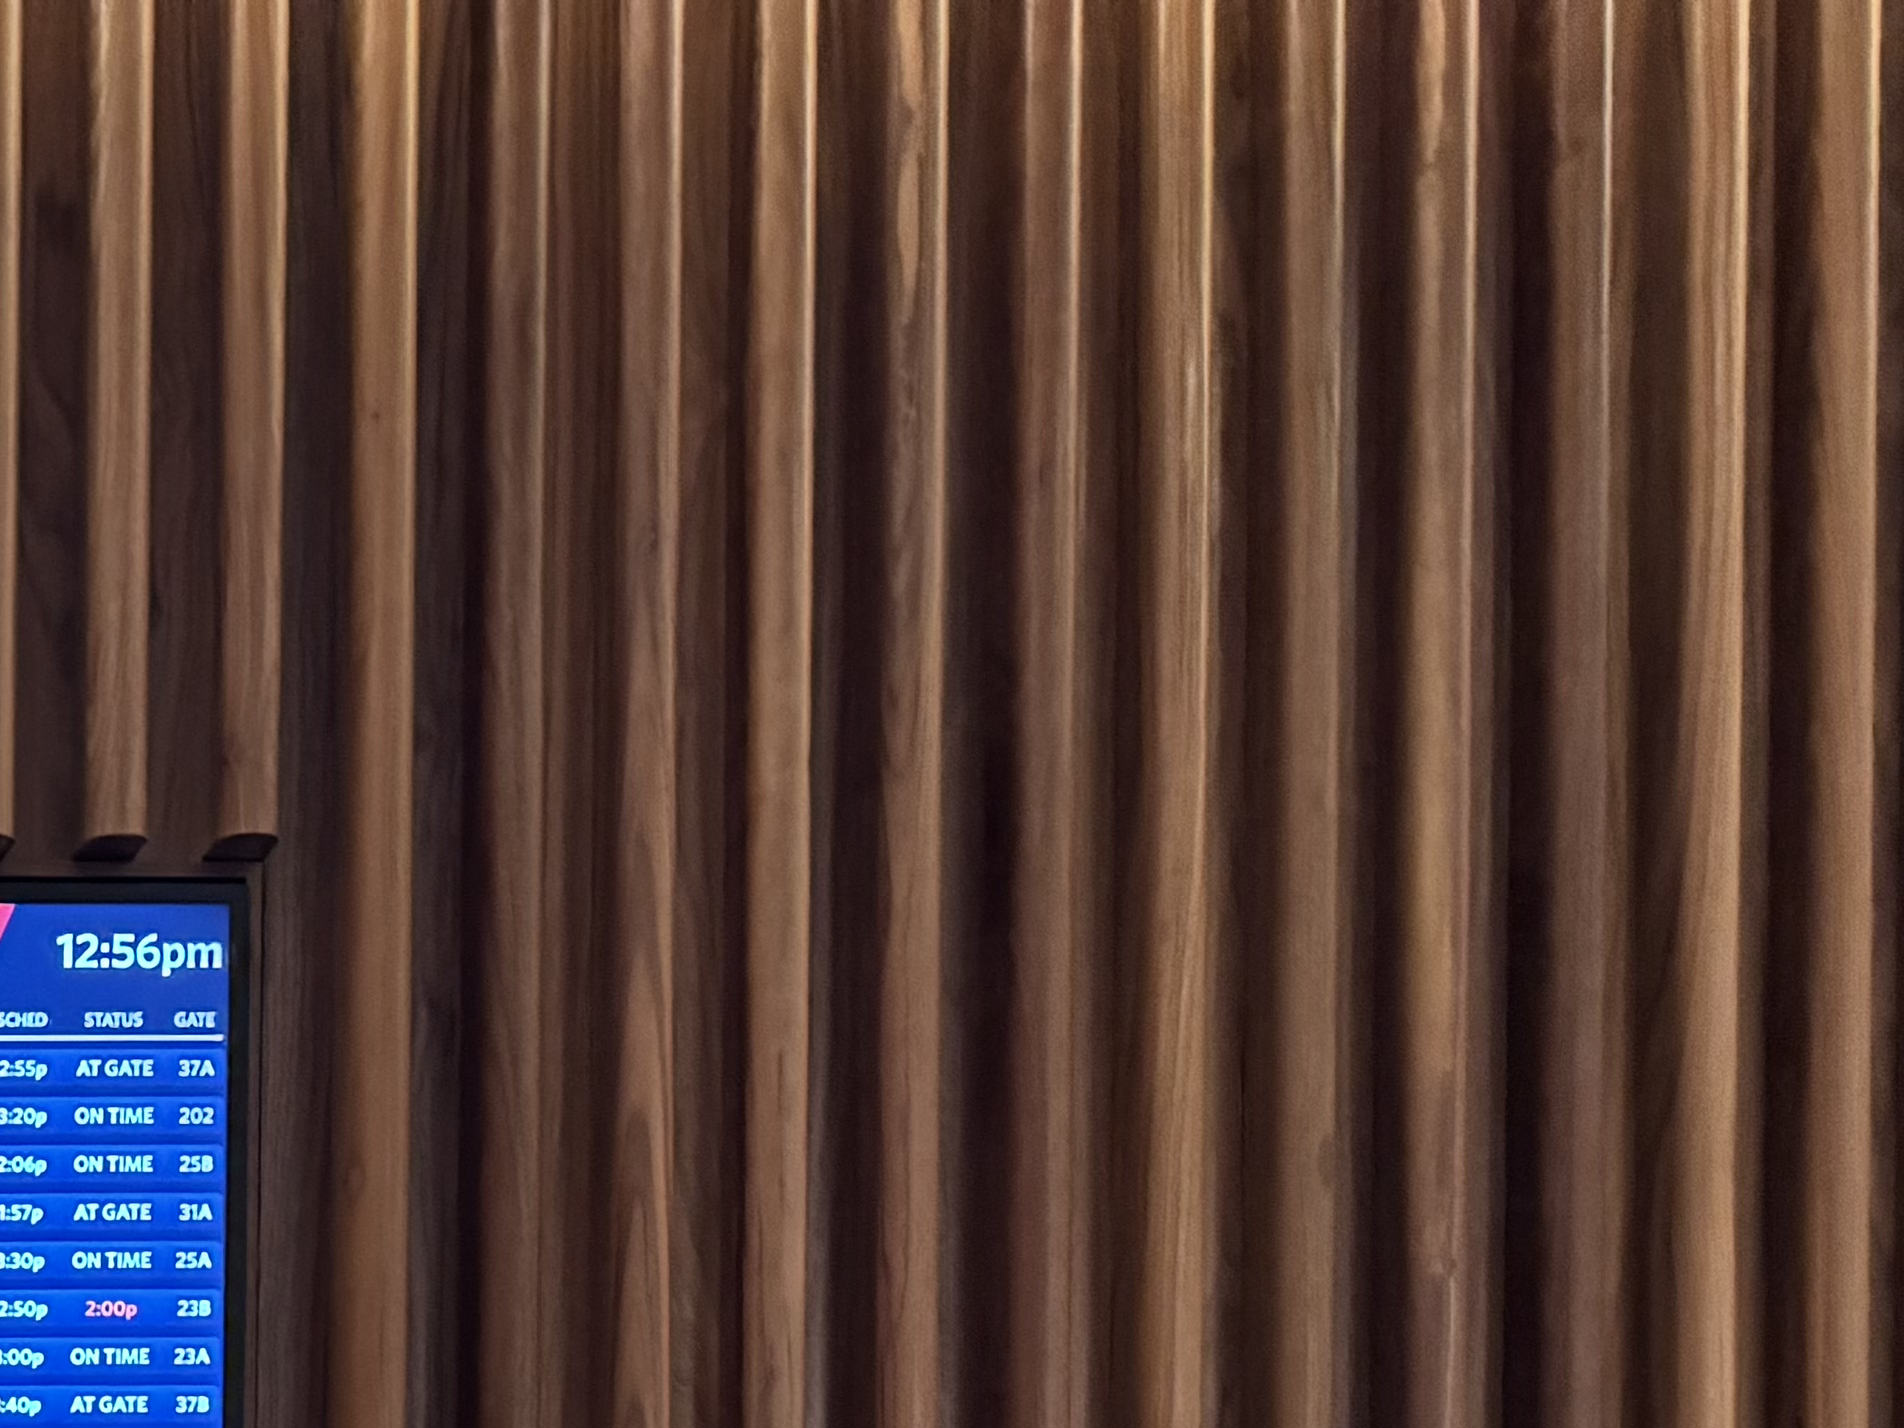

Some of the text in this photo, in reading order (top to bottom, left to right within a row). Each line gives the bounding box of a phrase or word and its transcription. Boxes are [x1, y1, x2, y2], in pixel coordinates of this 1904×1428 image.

[56, 932, 223, 978] 12:56pm
[84, 1011, 144, 1029] STATUS
[173, 1011, 216, 1028] GATE
[76, 1059, 102, 1077] AT
[104, 1059, 154, 1077] GATE
[178, 1059, 215, 1077] 37A
[71, 1251, 102, 1269] ON
[104, 1251, 152, 1269] TIME
[175, 1251, 212, 1269] 25A
